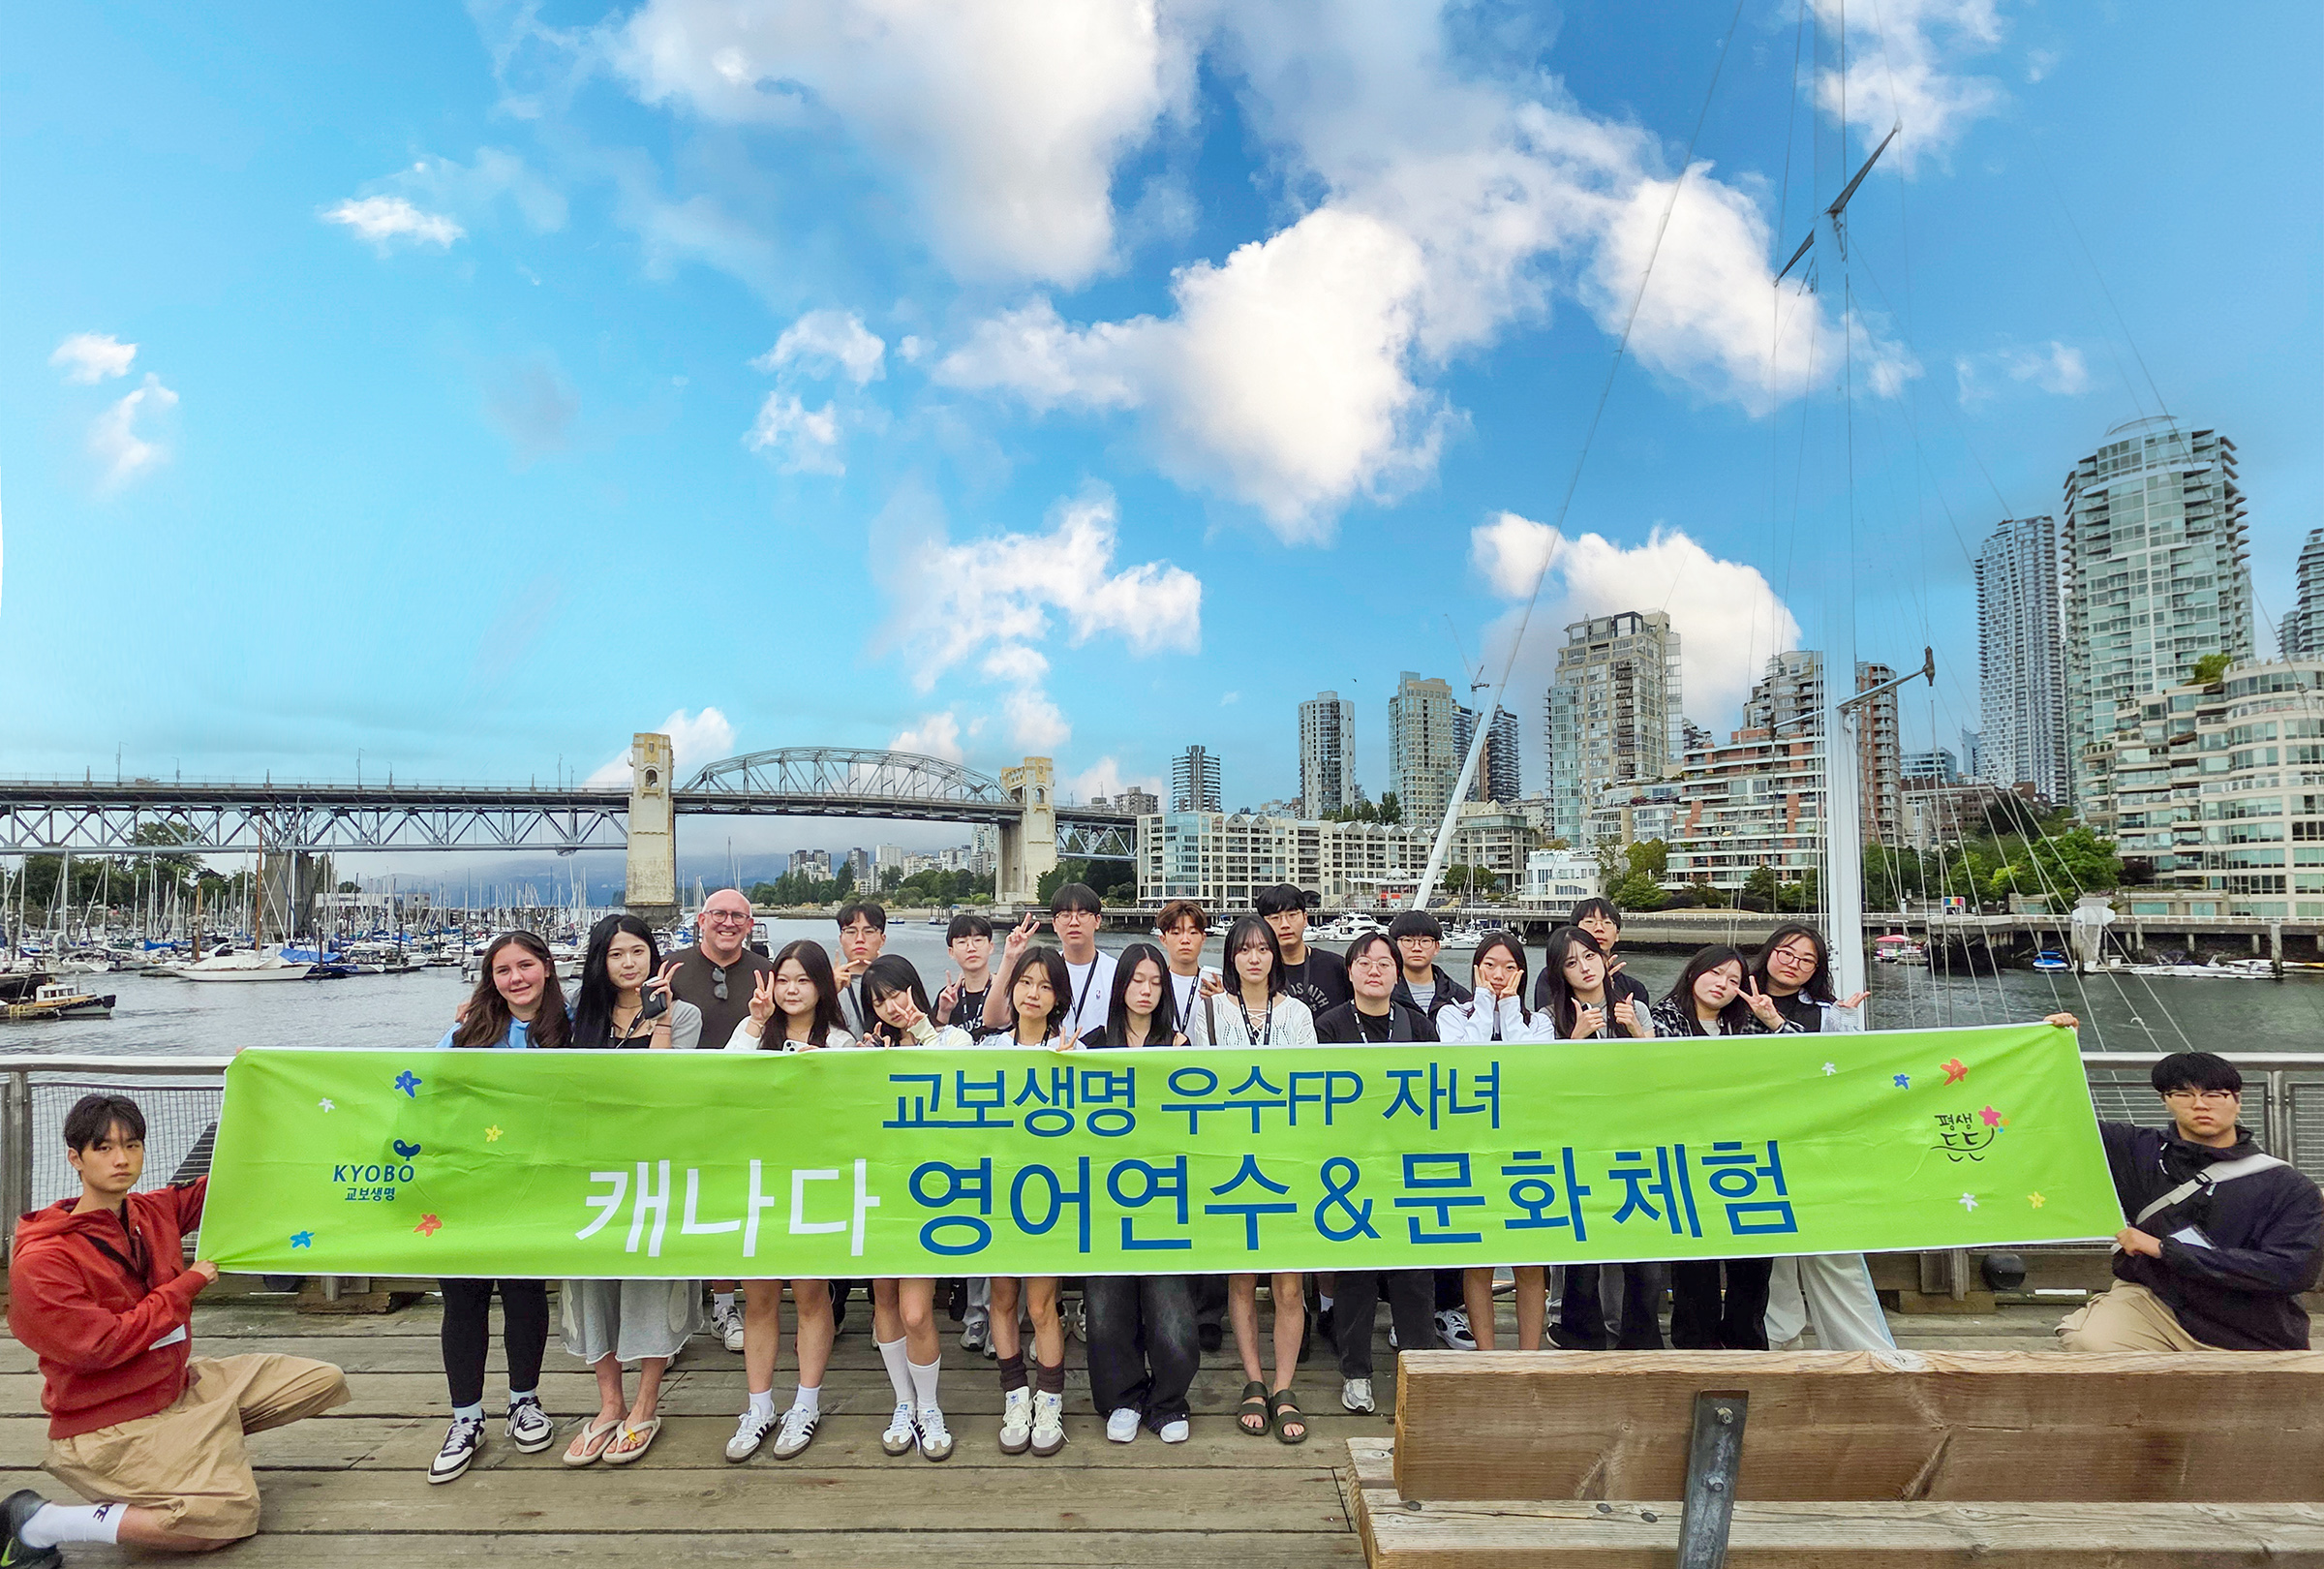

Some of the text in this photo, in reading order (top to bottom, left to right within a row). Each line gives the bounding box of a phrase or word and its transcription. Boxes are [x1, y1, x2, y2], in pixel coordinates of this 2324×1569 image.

[883, 1061, 1500, 1137] 교보생명 우수FP 자녀
[1934, 1113, 1972, 1131] 평생
[332, 1164, 414, 1183] KYOBO
[345, 1186, 396, 1202] 교보생명
[575, 1159, 880, 1257] 캐나다
[93, 1503, 114, 1523] KE
